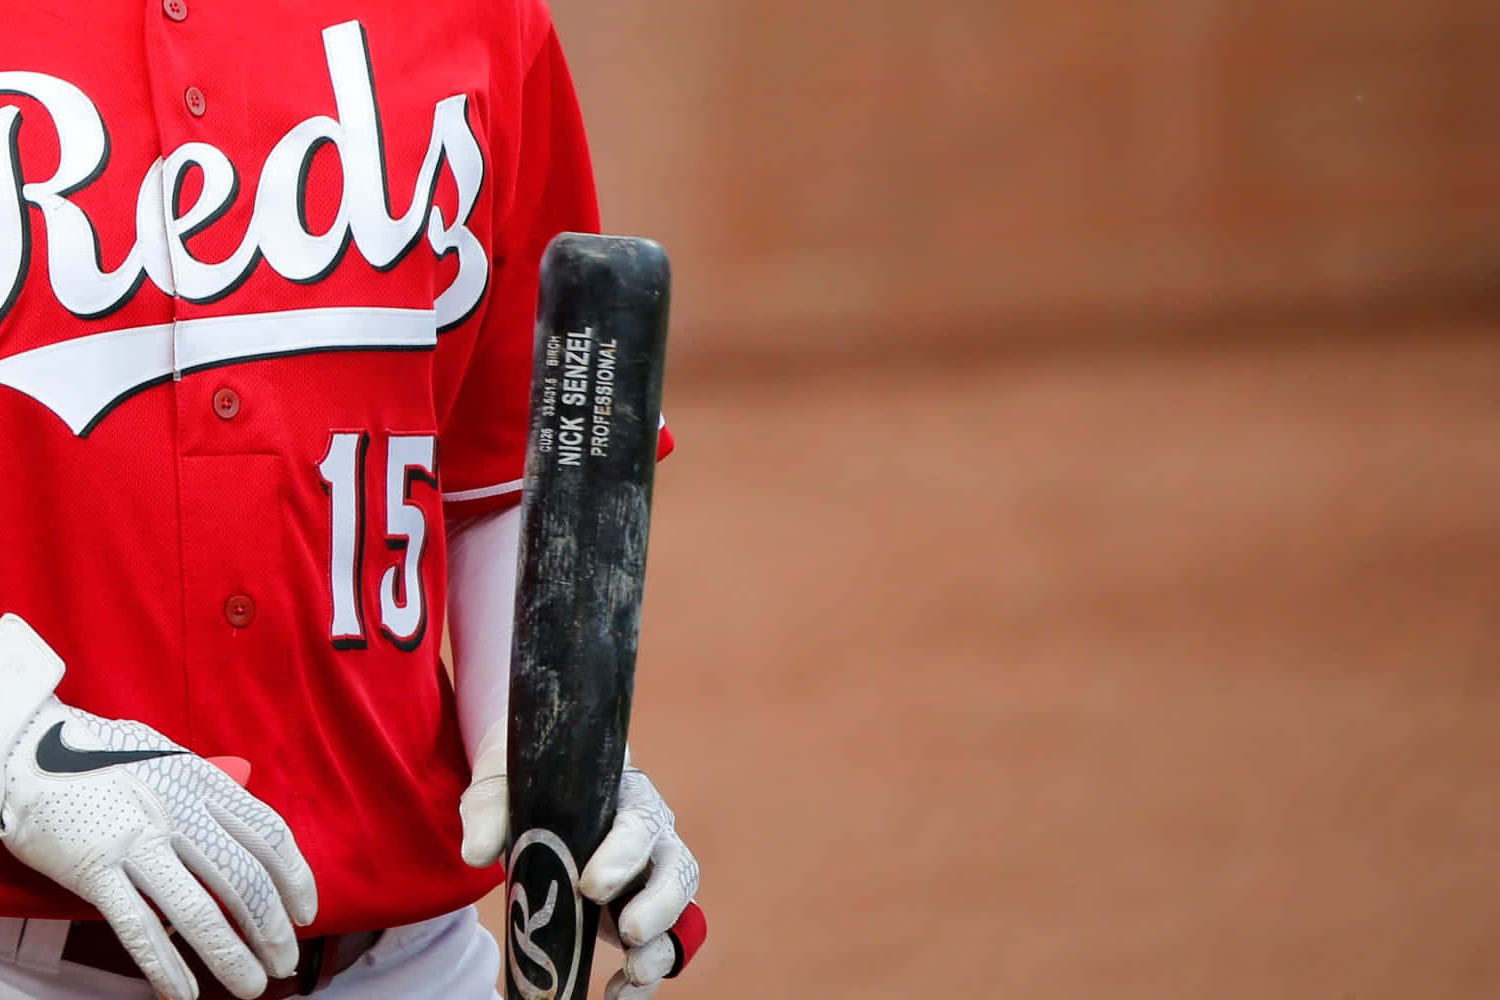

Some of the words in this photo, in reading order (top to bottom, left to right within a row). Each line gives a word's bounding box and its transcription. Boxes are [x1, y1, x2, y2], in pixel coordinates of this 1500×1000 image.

[546, 335, 561, 367] BIRCH
[561, 326, 593, 407] SENZEL
[591, 338, 617, 457] PROFESSIONAL
[558, 416, 585, 467] NICK
[315, 429, 438, 652] 15
